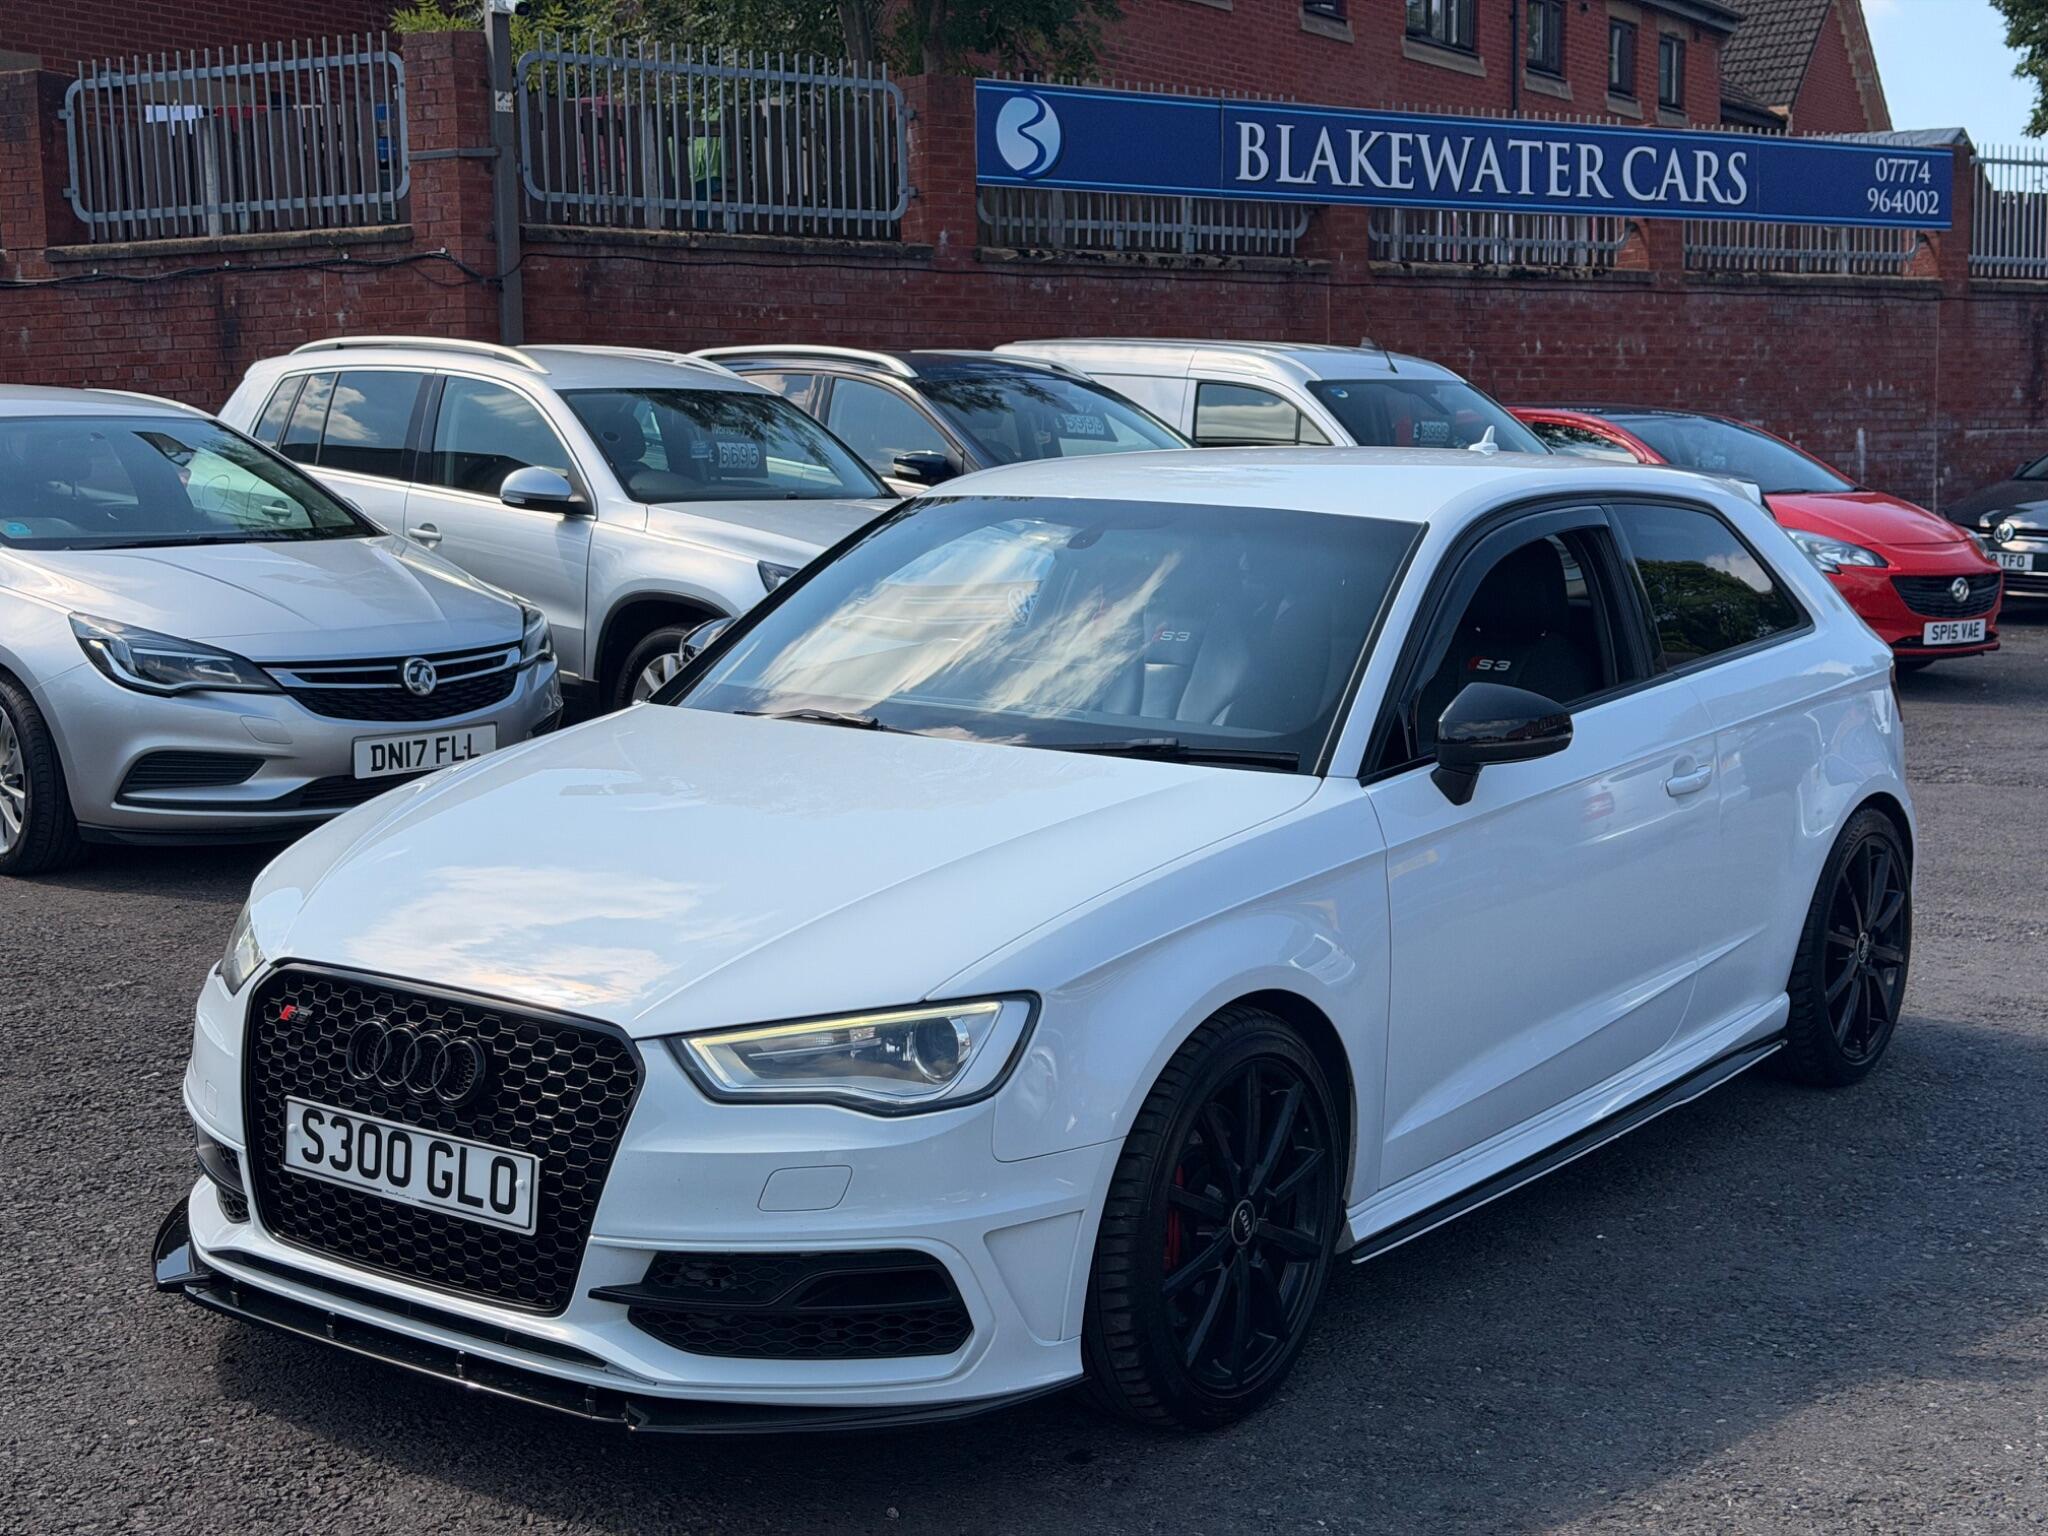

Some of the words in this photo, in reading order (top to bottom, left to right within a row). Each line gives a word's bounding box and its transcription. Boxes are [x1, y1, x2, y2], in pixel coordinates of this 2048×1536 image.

[1235, 121, 1614, 199] BLAKEWATER
[1622, 146, 1748, 206] CARS
[1875, 157, 1931, 184] 07774
[1867, 187, 1939, 215] 964002
[2000, 553, 2026, 568] TFO
[1159, 631, 1191, 642] S3
[1932, 623, 1959, 641] SP15
[1961, 621, 1981, 639] VAE
[1476, 658, 1512, 671] S3
[370, 739, 428, 772] DN17
[435, 733, 481, 765] FLL
[301, 1108, 413, 1188] S300
[427, 1140, 518, 1215] GLO
